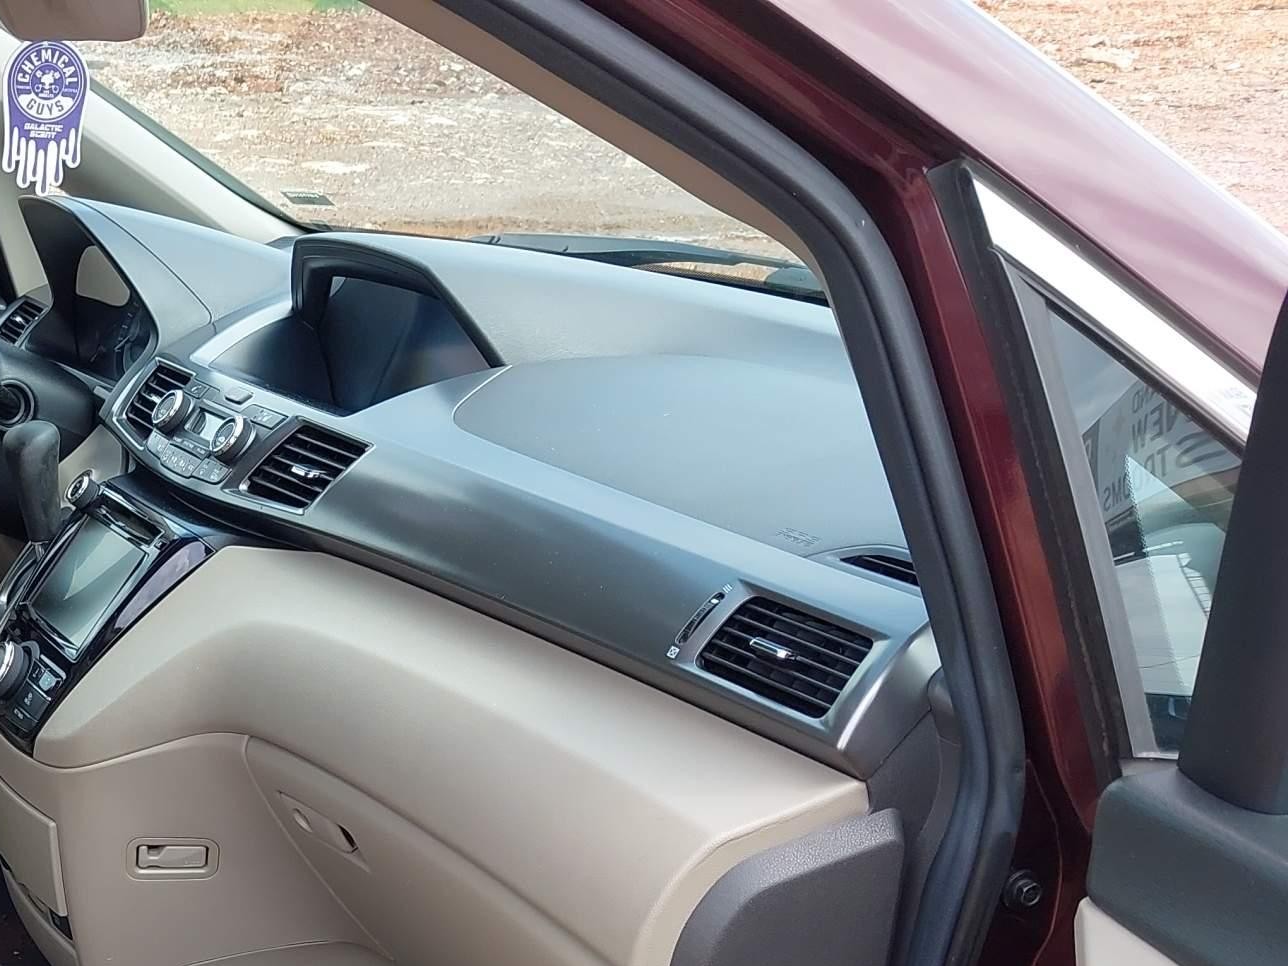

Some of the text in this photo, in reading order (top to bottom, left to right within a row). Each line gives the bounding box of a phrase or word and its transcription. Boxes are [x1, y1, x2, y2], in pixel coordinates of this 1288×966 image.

[17, 48, 78, 85] CHEMICAL
[26, 98, 65, 116] GUYS
[23, 122, 64, 132] GALACTIC
